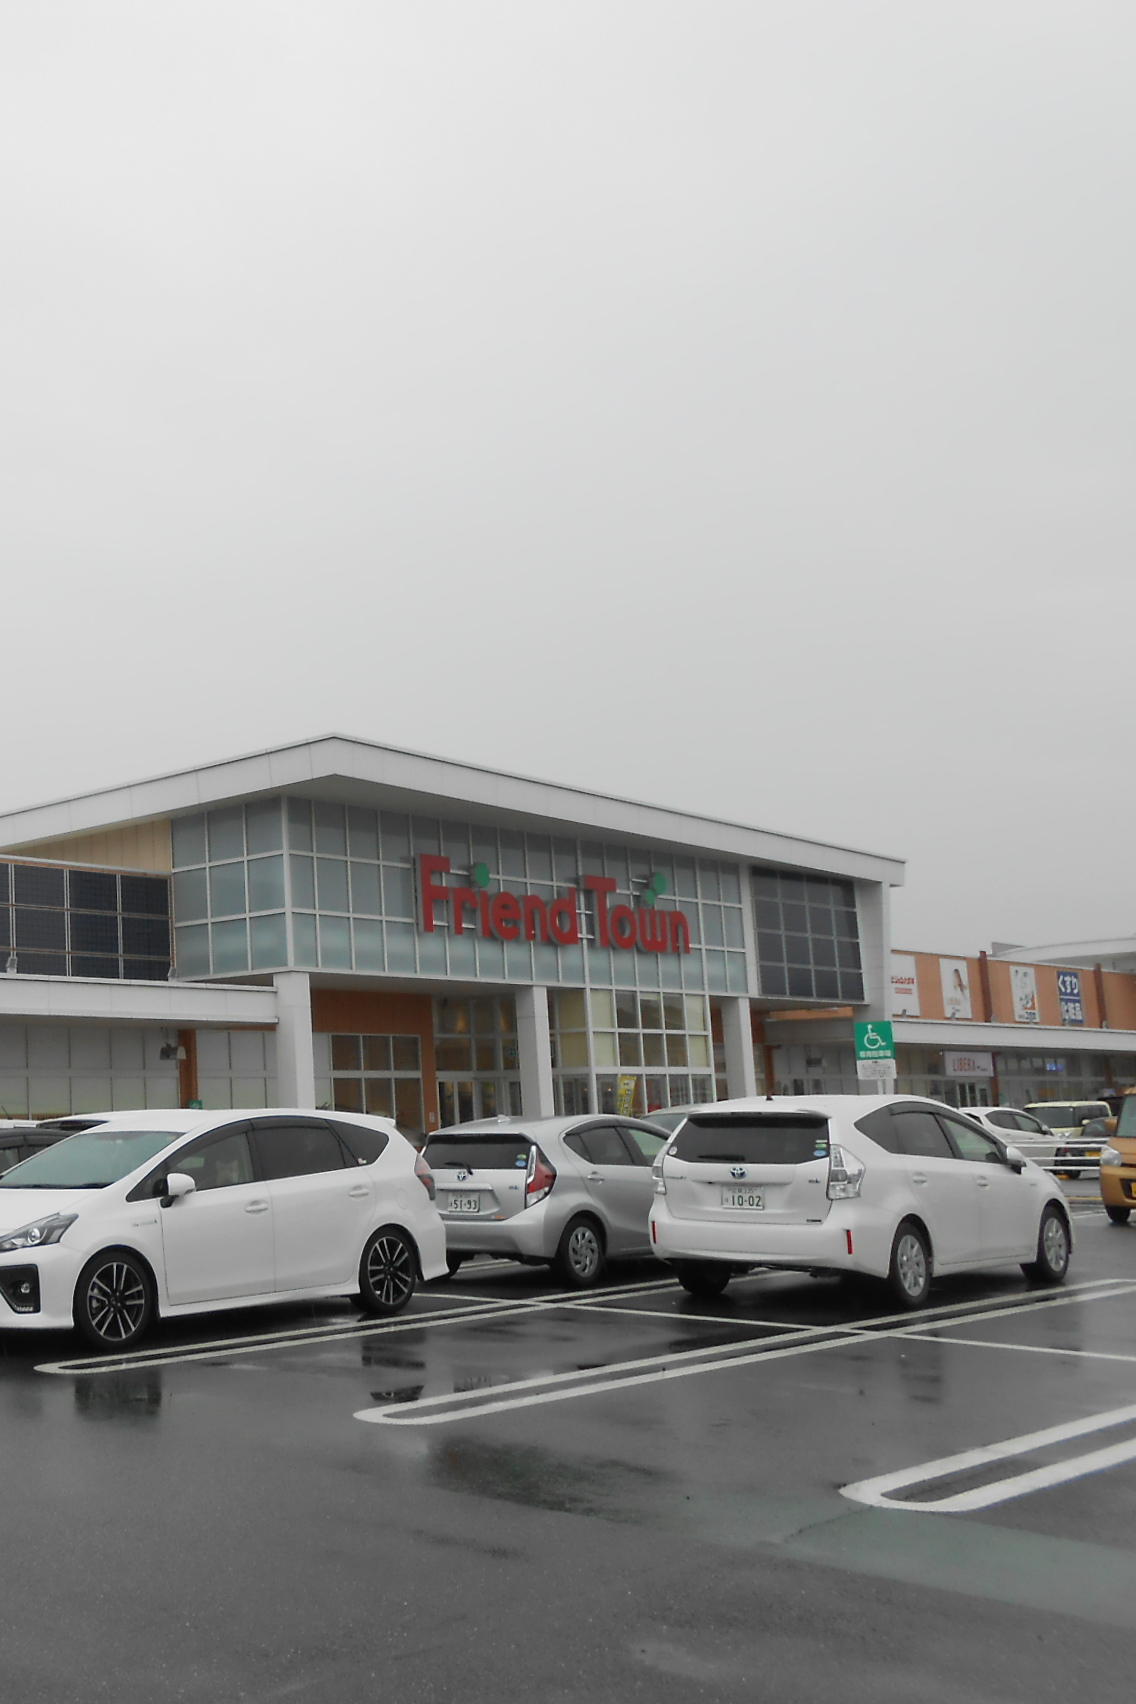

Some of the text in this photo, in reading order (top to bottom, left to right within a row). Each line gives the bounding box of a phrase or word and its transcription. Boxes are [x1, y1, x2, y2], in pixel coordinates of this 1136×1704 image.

[419, 853, 692, 955] Friend Town
[1058, 974, 1080, 994] くすり
[453, 1199, 478, 1210] 51-93
[731, 1194, 762, 1207] 10-02
